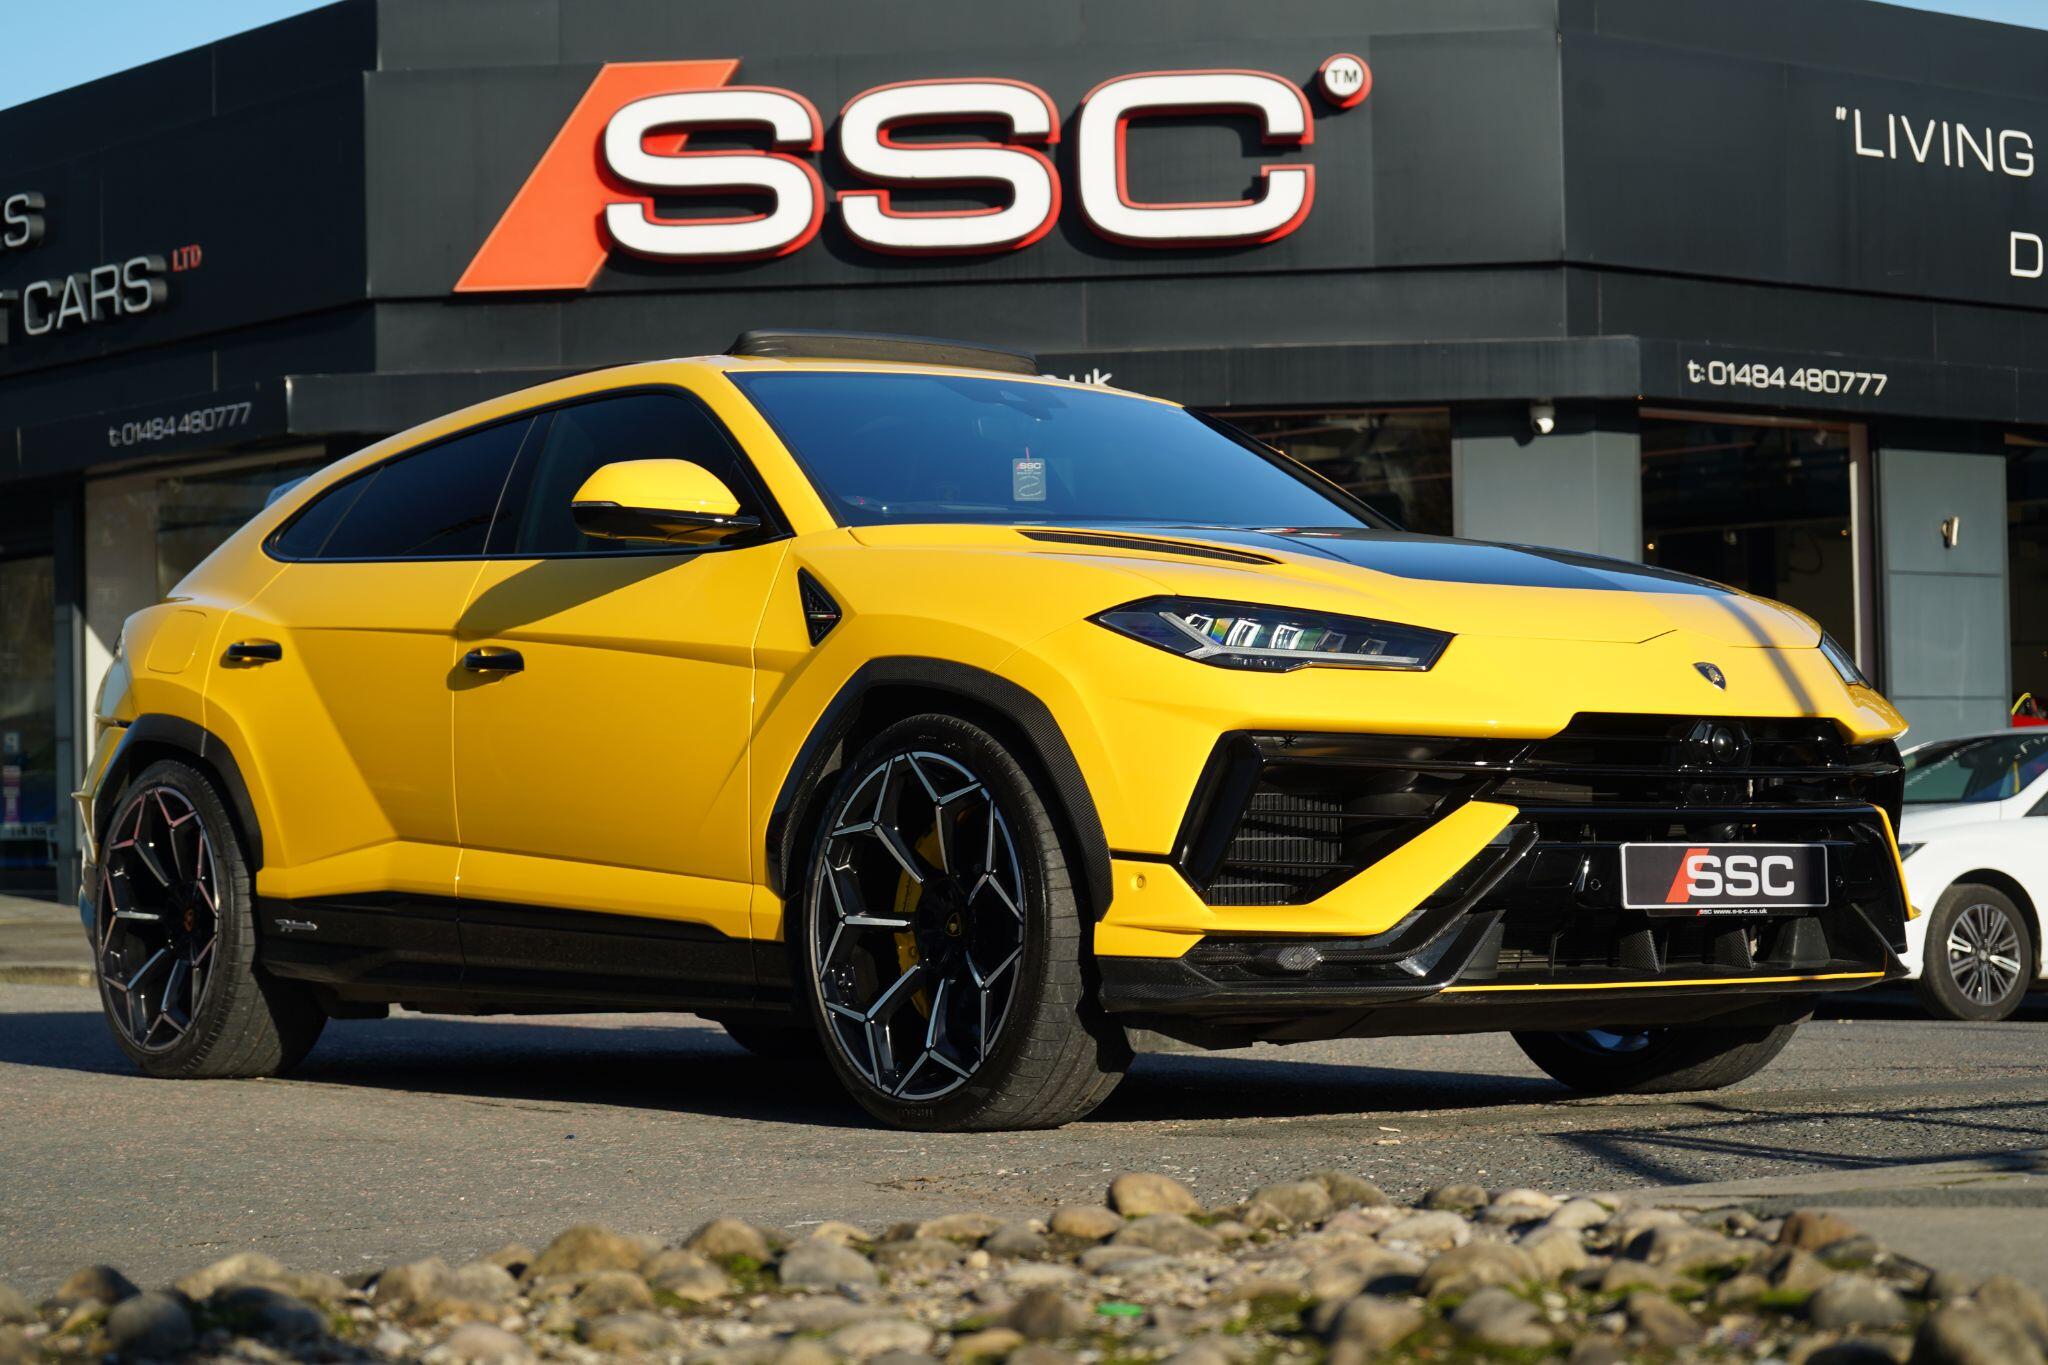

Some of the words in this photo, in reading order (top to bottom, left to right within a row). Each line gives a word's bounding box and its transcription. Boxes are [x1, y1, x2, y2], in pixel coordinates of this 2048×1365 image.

[603, 70, 1314, 262] SSC
[1330, 68, 1358, 84] TM
[1836, 106, 2035, 177] "LIVING
[24, 255, 162, 336] CARS
[172, 244, 202, 272] LTD
[1789, 367, 1888, 397] 480777
[177, 401, 252, 434] 480777
[1686, 855, 1795, 897] SSC
